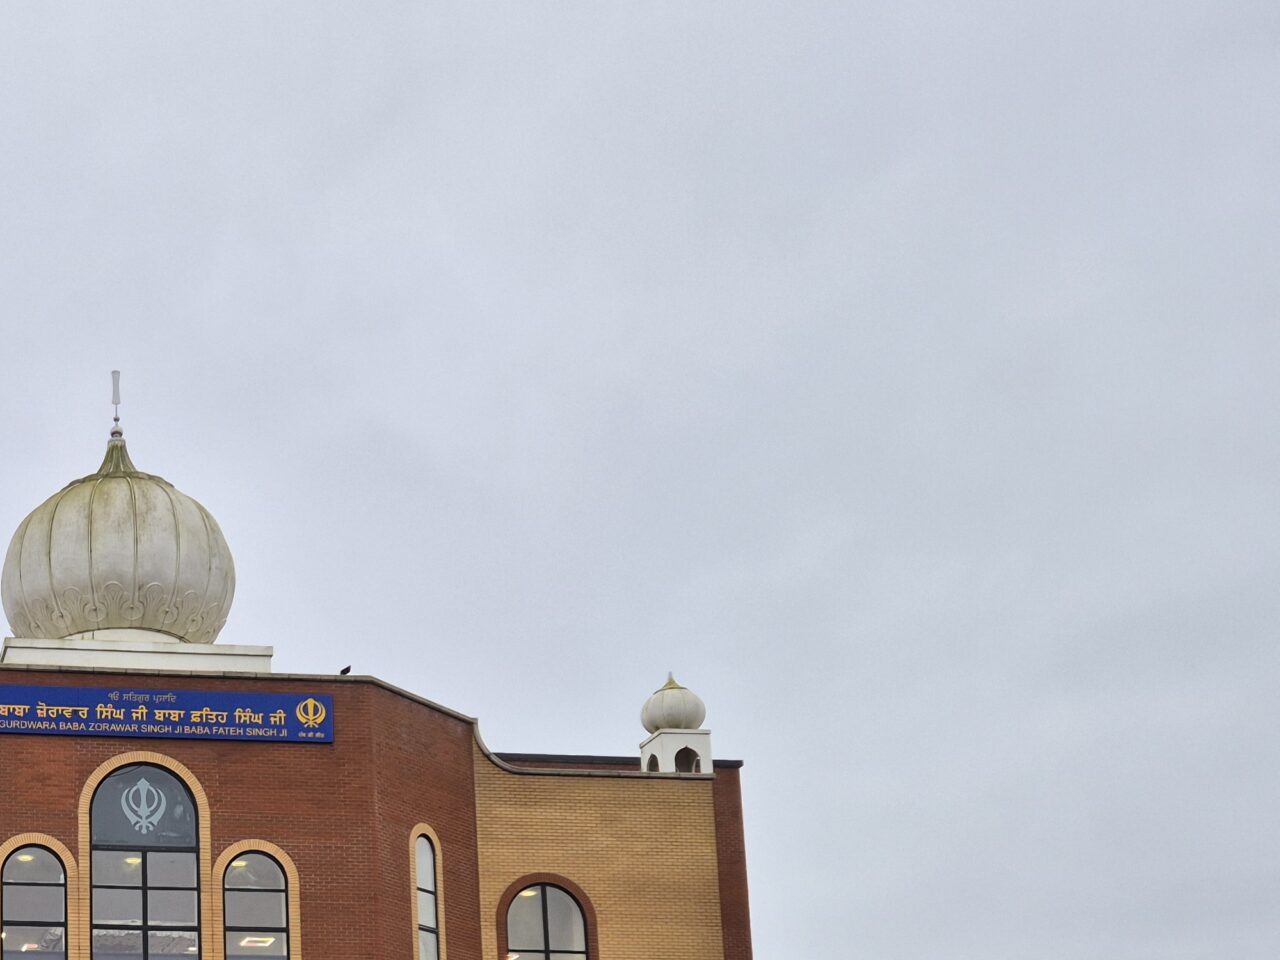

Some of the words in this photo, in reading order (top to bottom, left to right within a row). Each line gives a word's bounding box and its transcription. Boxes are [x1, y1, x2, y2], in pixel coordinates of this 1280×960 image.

[95, 703, 125, 720] ਸਿੰਘ
[131, 705, 148, 721] ਜੀ
[154, 709, 185, 722] ਬਾਬਾ
[234, 708, 264, 724] ਸਿੰਘ
[269, 709, 286, 725] ਜੀ
[59, 721, 86, 731] BABA
[88, 723, 138, 733] ZORAWAR
[141, 724, 172, 733] SINGH
[174, 726, 183, 734] JI
[184, 725, 210, 735] BABA
[212, 726, 243, 736] FATEH
[246, 728, 277, 737] SINGH
[279, 728, 287, 737] JI
